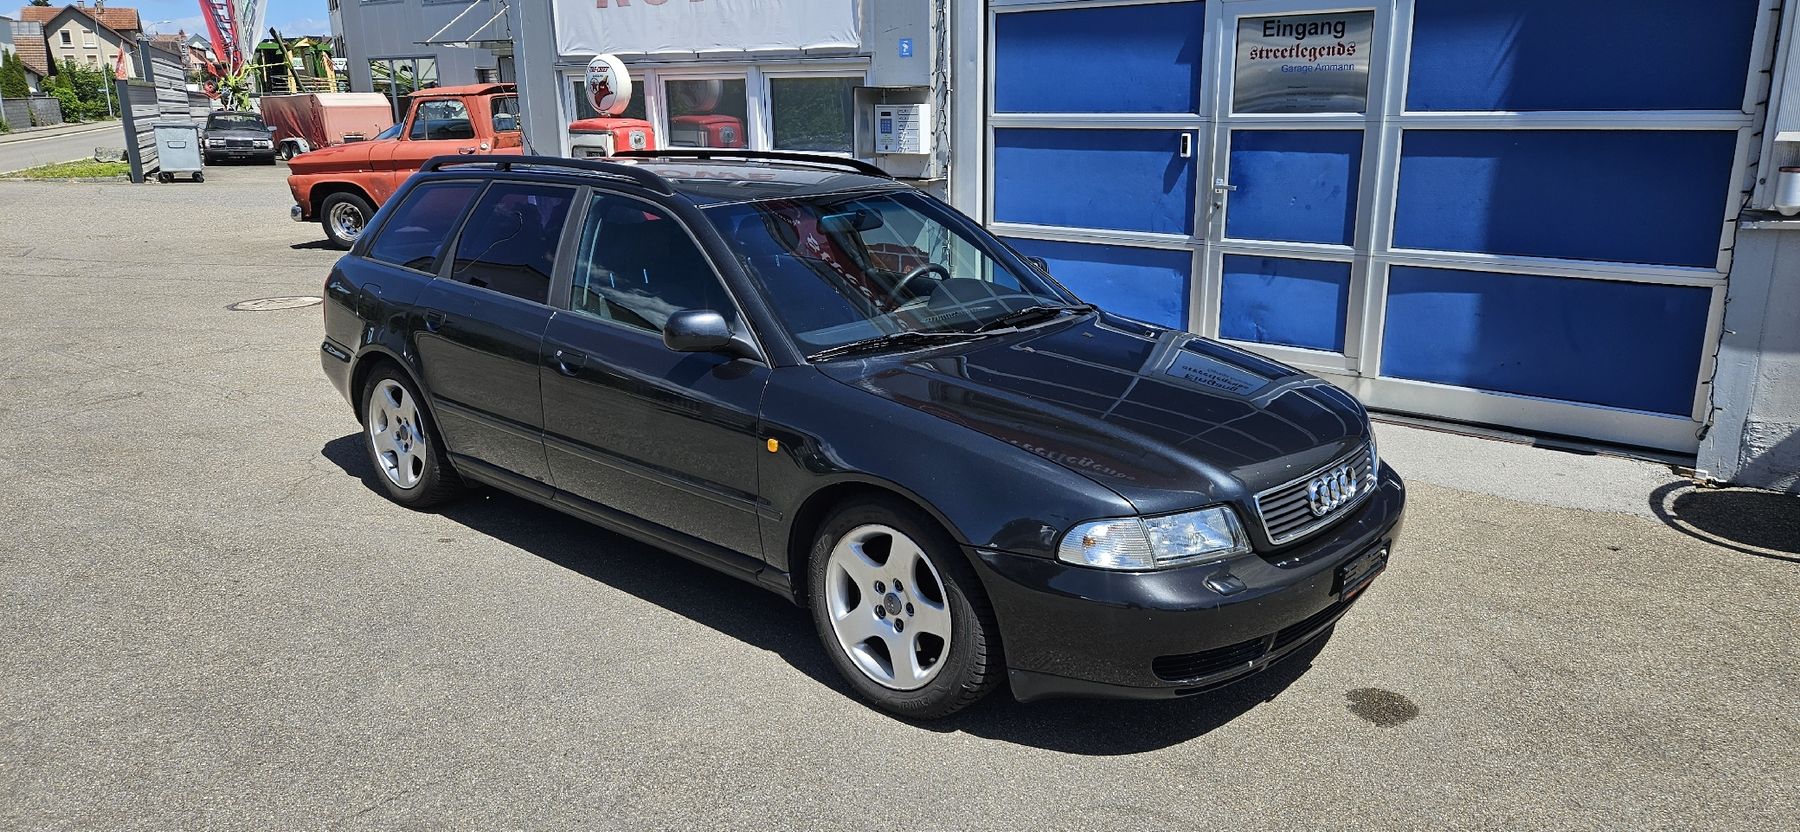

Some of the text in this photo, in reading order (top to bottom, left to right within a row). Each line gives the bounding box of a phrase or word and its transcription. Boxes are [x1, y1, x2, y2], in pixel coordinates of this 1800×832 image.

[1263, 20, 1346, 40] Eingang
[1250, 41, 1356, 62] streetlegends
[1281, 63, 1355, 73] Garage Ammann
